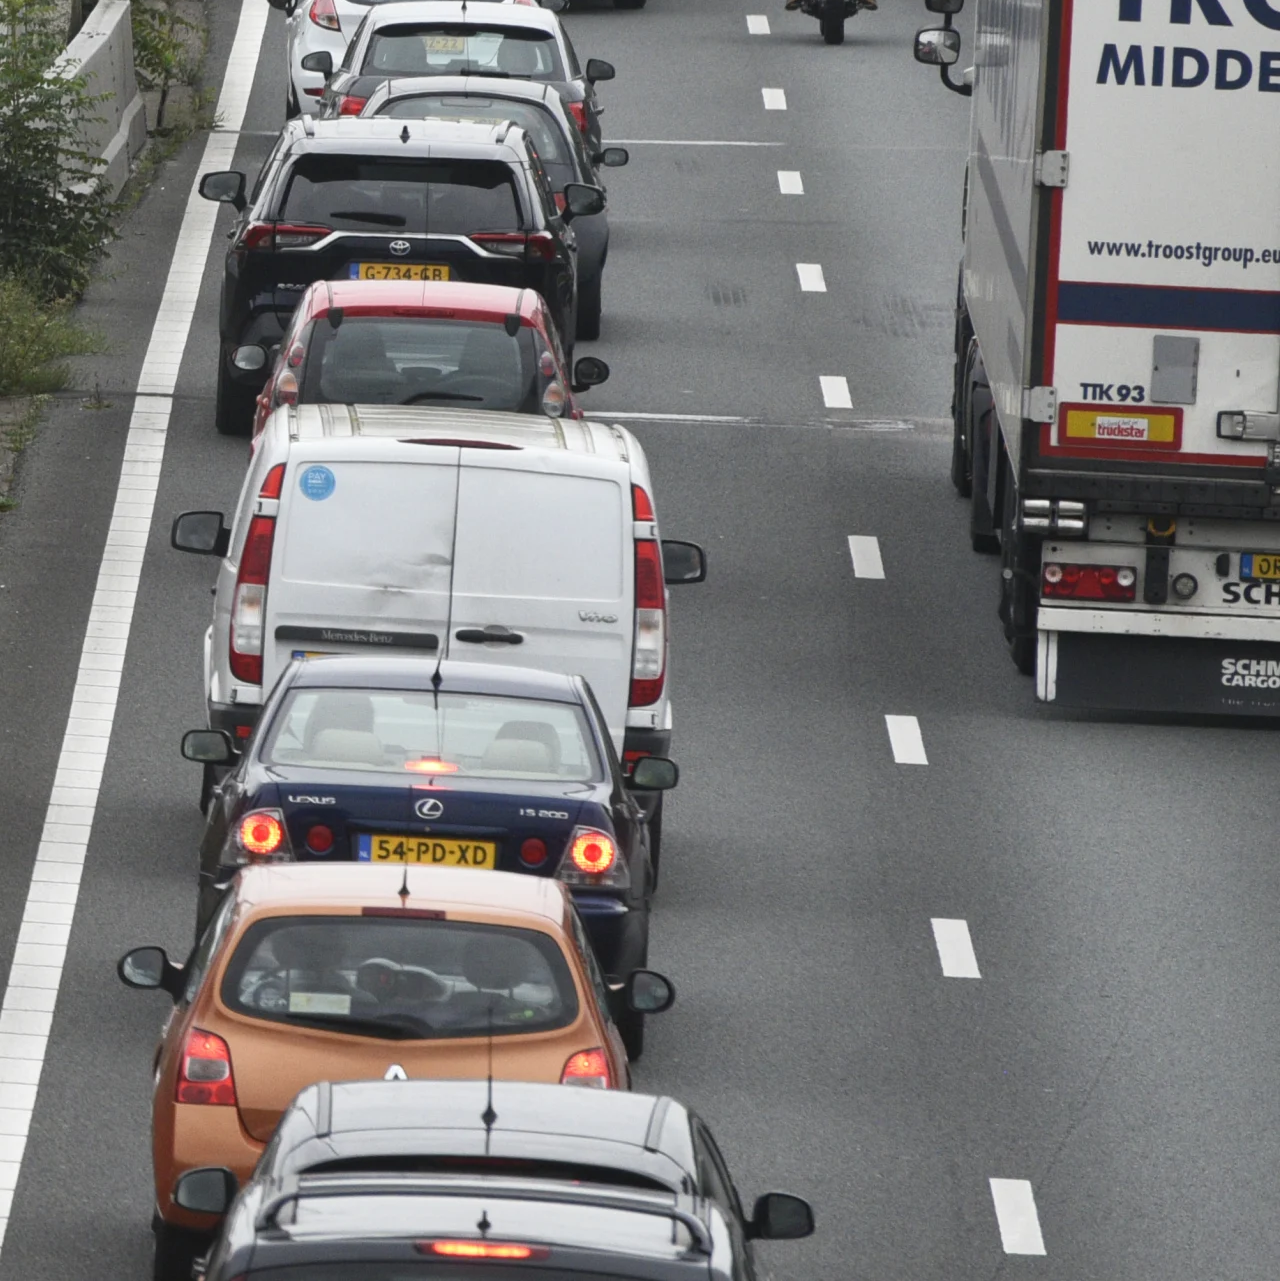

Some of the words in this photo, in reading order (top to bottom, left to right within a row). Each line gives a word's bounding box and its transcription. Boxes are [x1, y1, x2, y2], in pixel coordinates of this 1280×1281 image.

[1087, 239, 1280, 267] www.troostgroup.eu
[1080, 382, 1115, 402] TTK
[1117, 384, 1145, 403] 93
[1097, 424, 1146, 439] truckstar
[321, 629, 393, 644] Mercedes-Benz
[288, 795, 336, 805] LEXUS
[377, 840, 487, 864] 54-PD-XD
